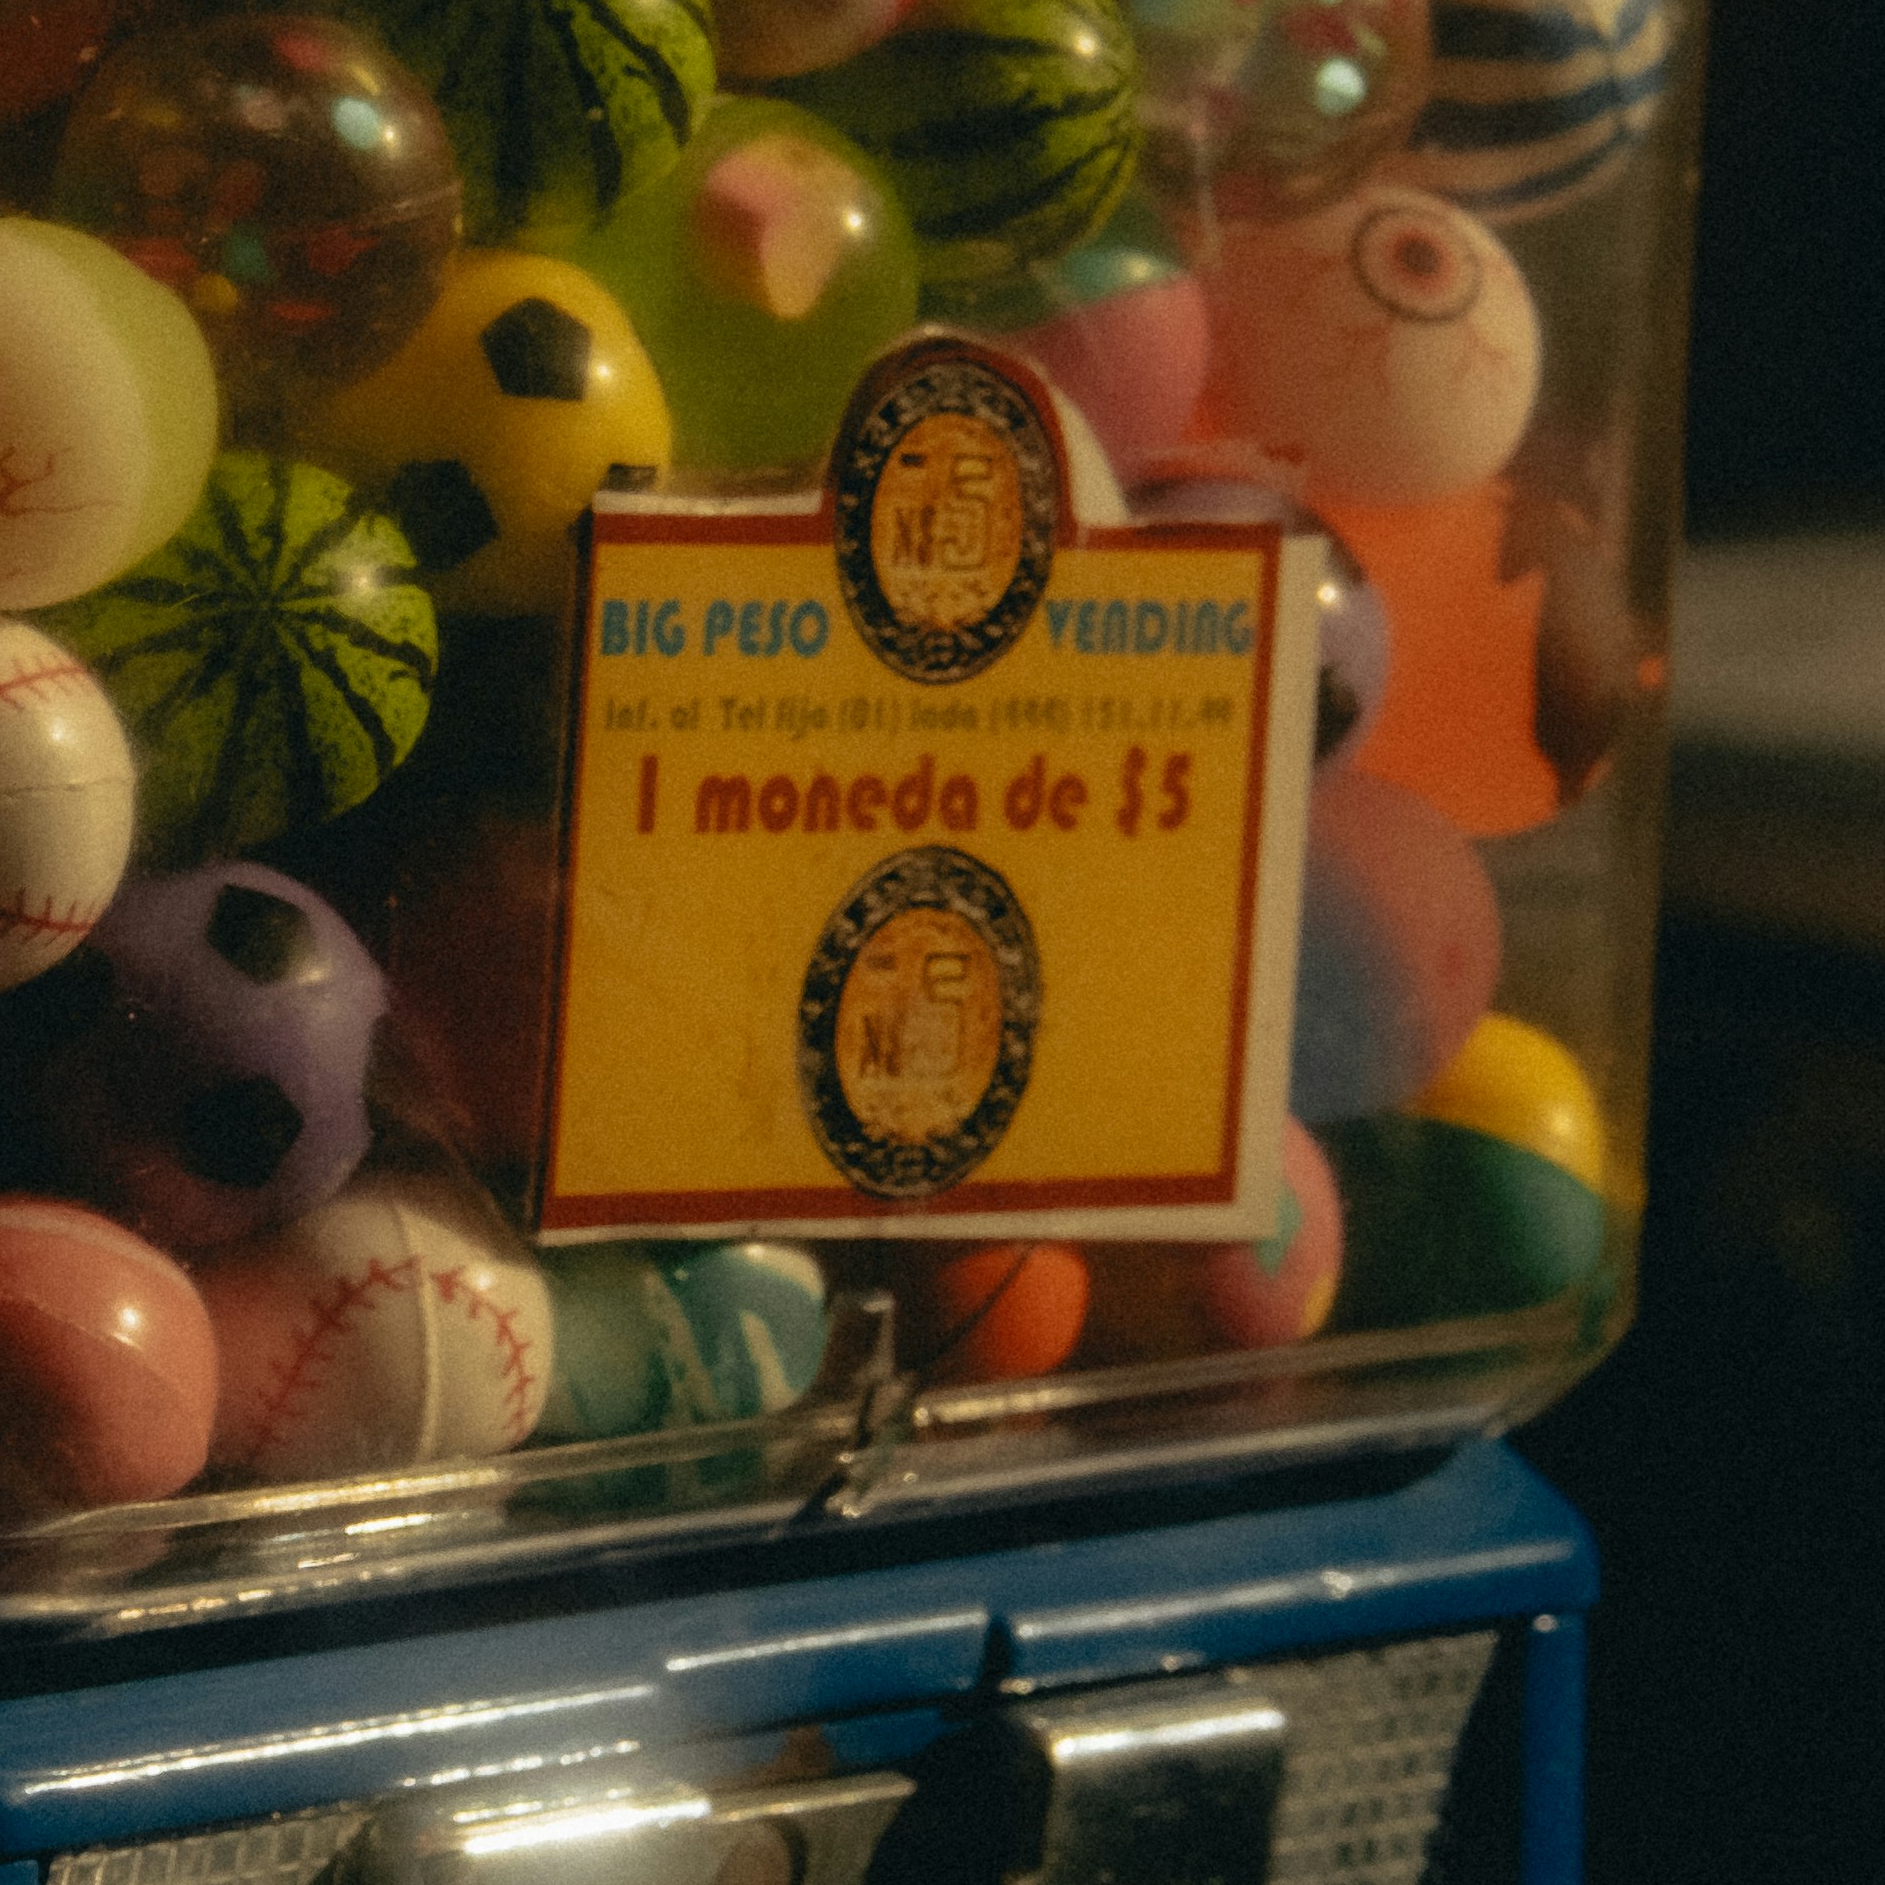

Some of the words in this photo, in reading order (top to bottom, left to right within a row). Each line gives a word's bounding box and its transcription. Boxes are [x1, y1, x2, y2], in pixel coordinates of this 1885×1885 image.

[599, 599, 685, 657] BIG
[703, 599, 830, 658] PESO
[1046, 598, 1254, 655] VENDING
[695, 755, 980, 835] moneda
[1002, 753, 1089, 833] de
[1116, 746, 1192, 838] $5
